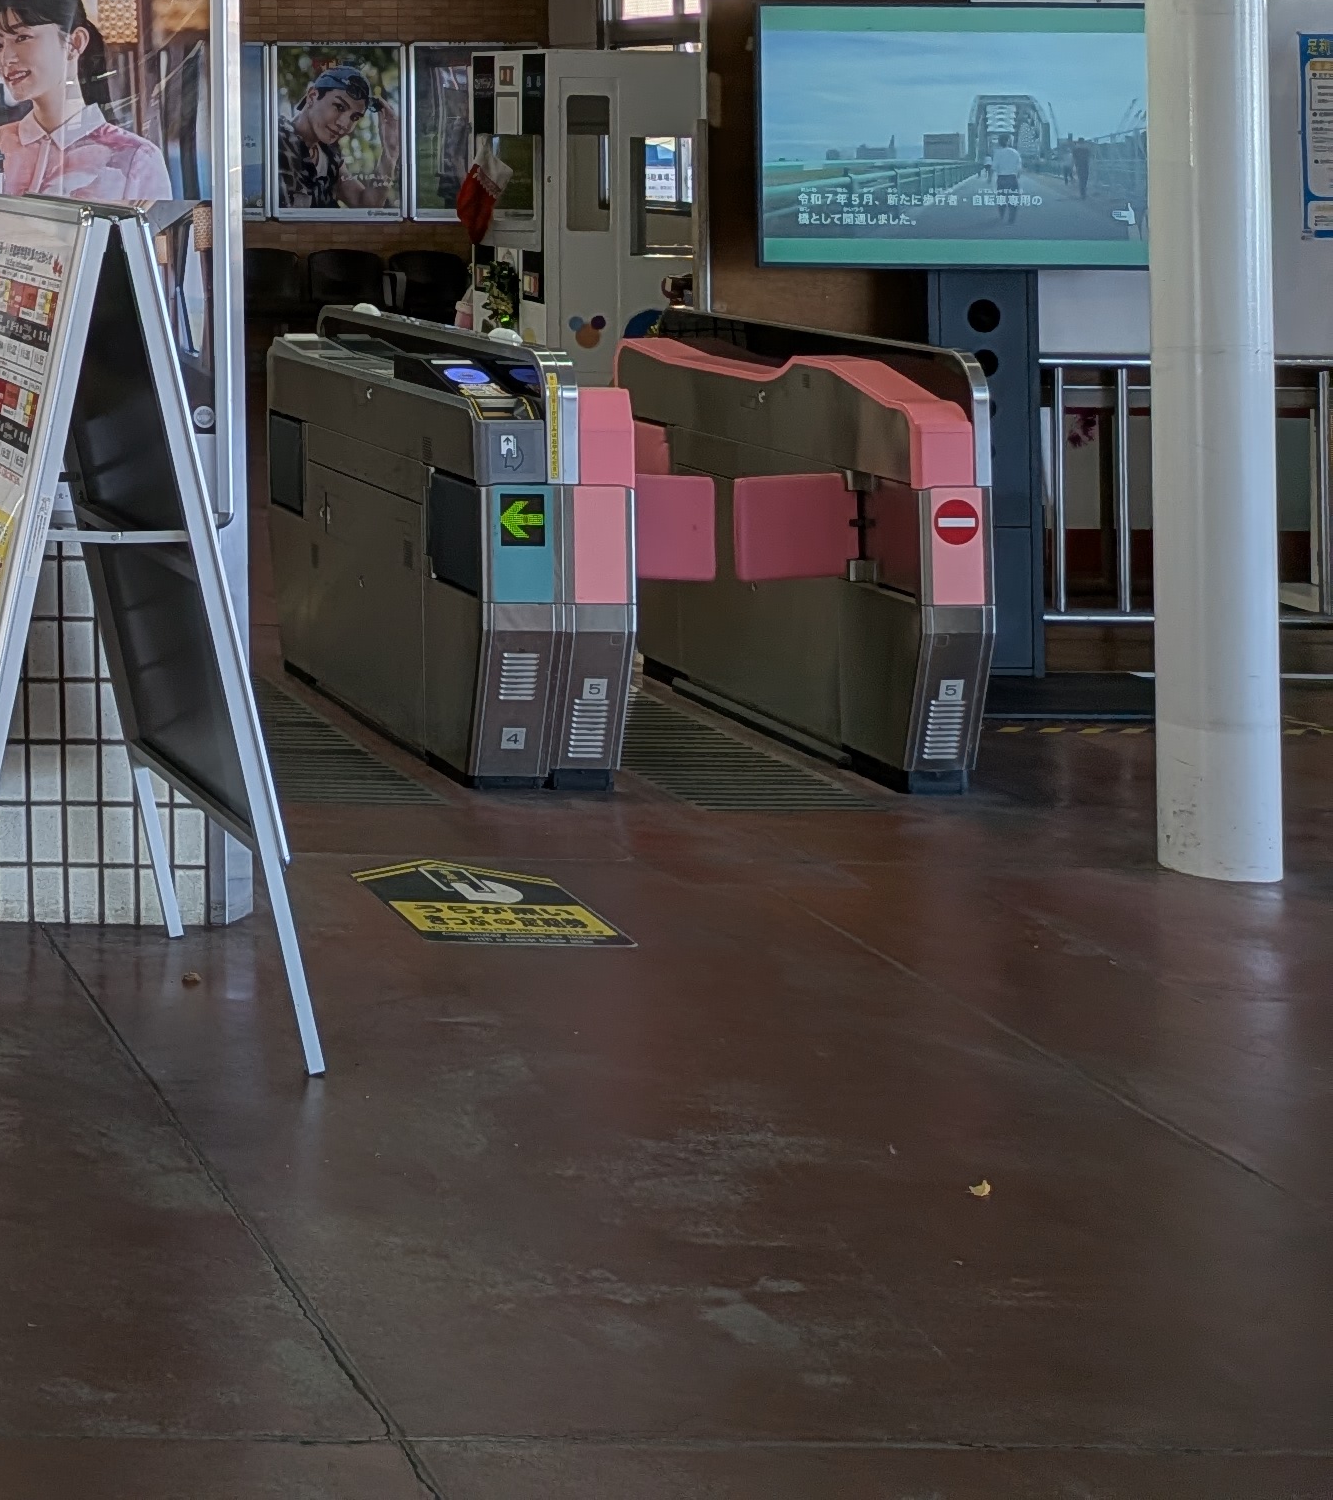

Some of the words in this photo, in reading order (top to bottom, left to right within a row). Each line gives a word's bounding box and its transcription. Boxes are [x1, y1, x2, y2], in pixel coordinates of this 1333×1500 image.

[589, 683, 602, 696] 5
[944, 684, 958, 697] 5
[506, 732, 520, 745] 4
